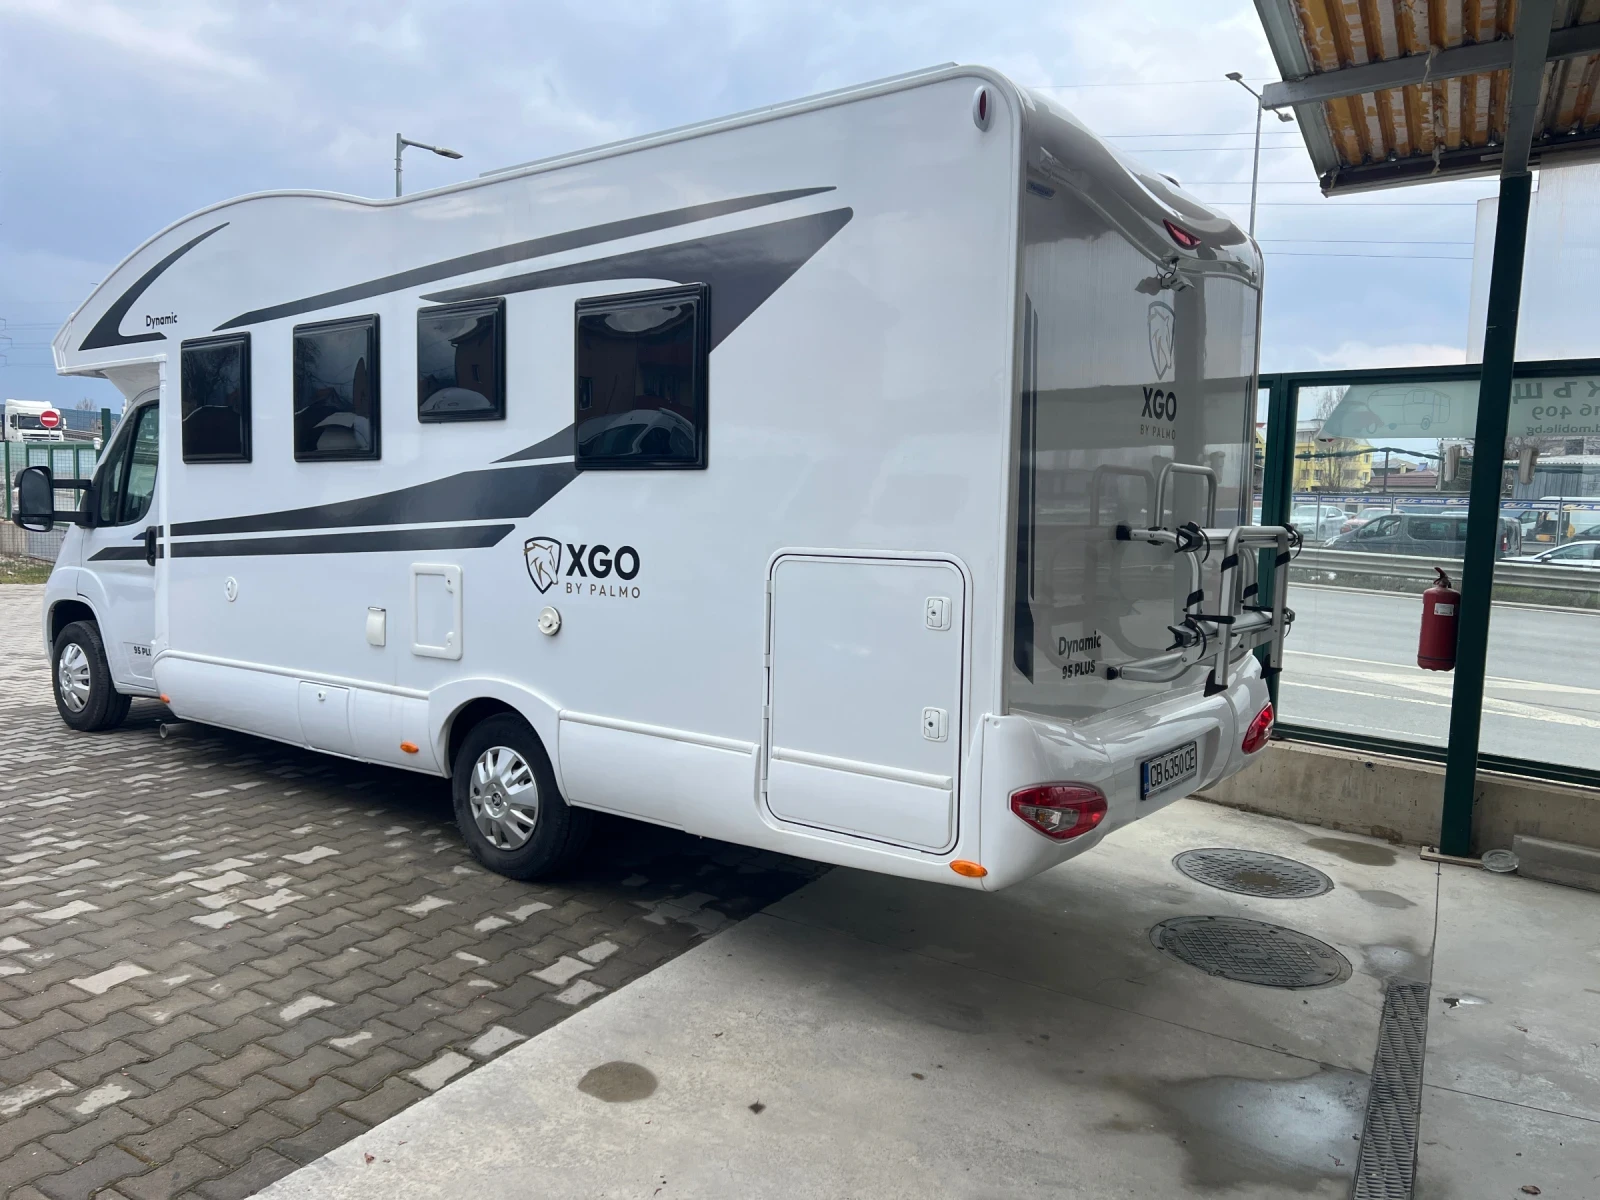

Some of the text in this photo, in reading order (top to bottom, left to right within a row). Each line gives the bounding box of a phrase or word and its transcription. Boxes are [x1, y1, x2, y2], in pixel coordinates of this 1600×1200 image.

[146, 312, 177, 329] Dynamic
[1142, 386, 1177, 422] XGO
[1140, 424, 1176, 440] BY PALMO
[566, 544, 640, 580] XGO
[566, 582, 640, 599] BY PALMO
[134, 646, 141, 654] 95
[1059, 630, 1101, 659] Dynamic
[1062, 660, 1096, 679] 95 PLUS
[1151, 747, 1195, 787] CB 6350 CE
